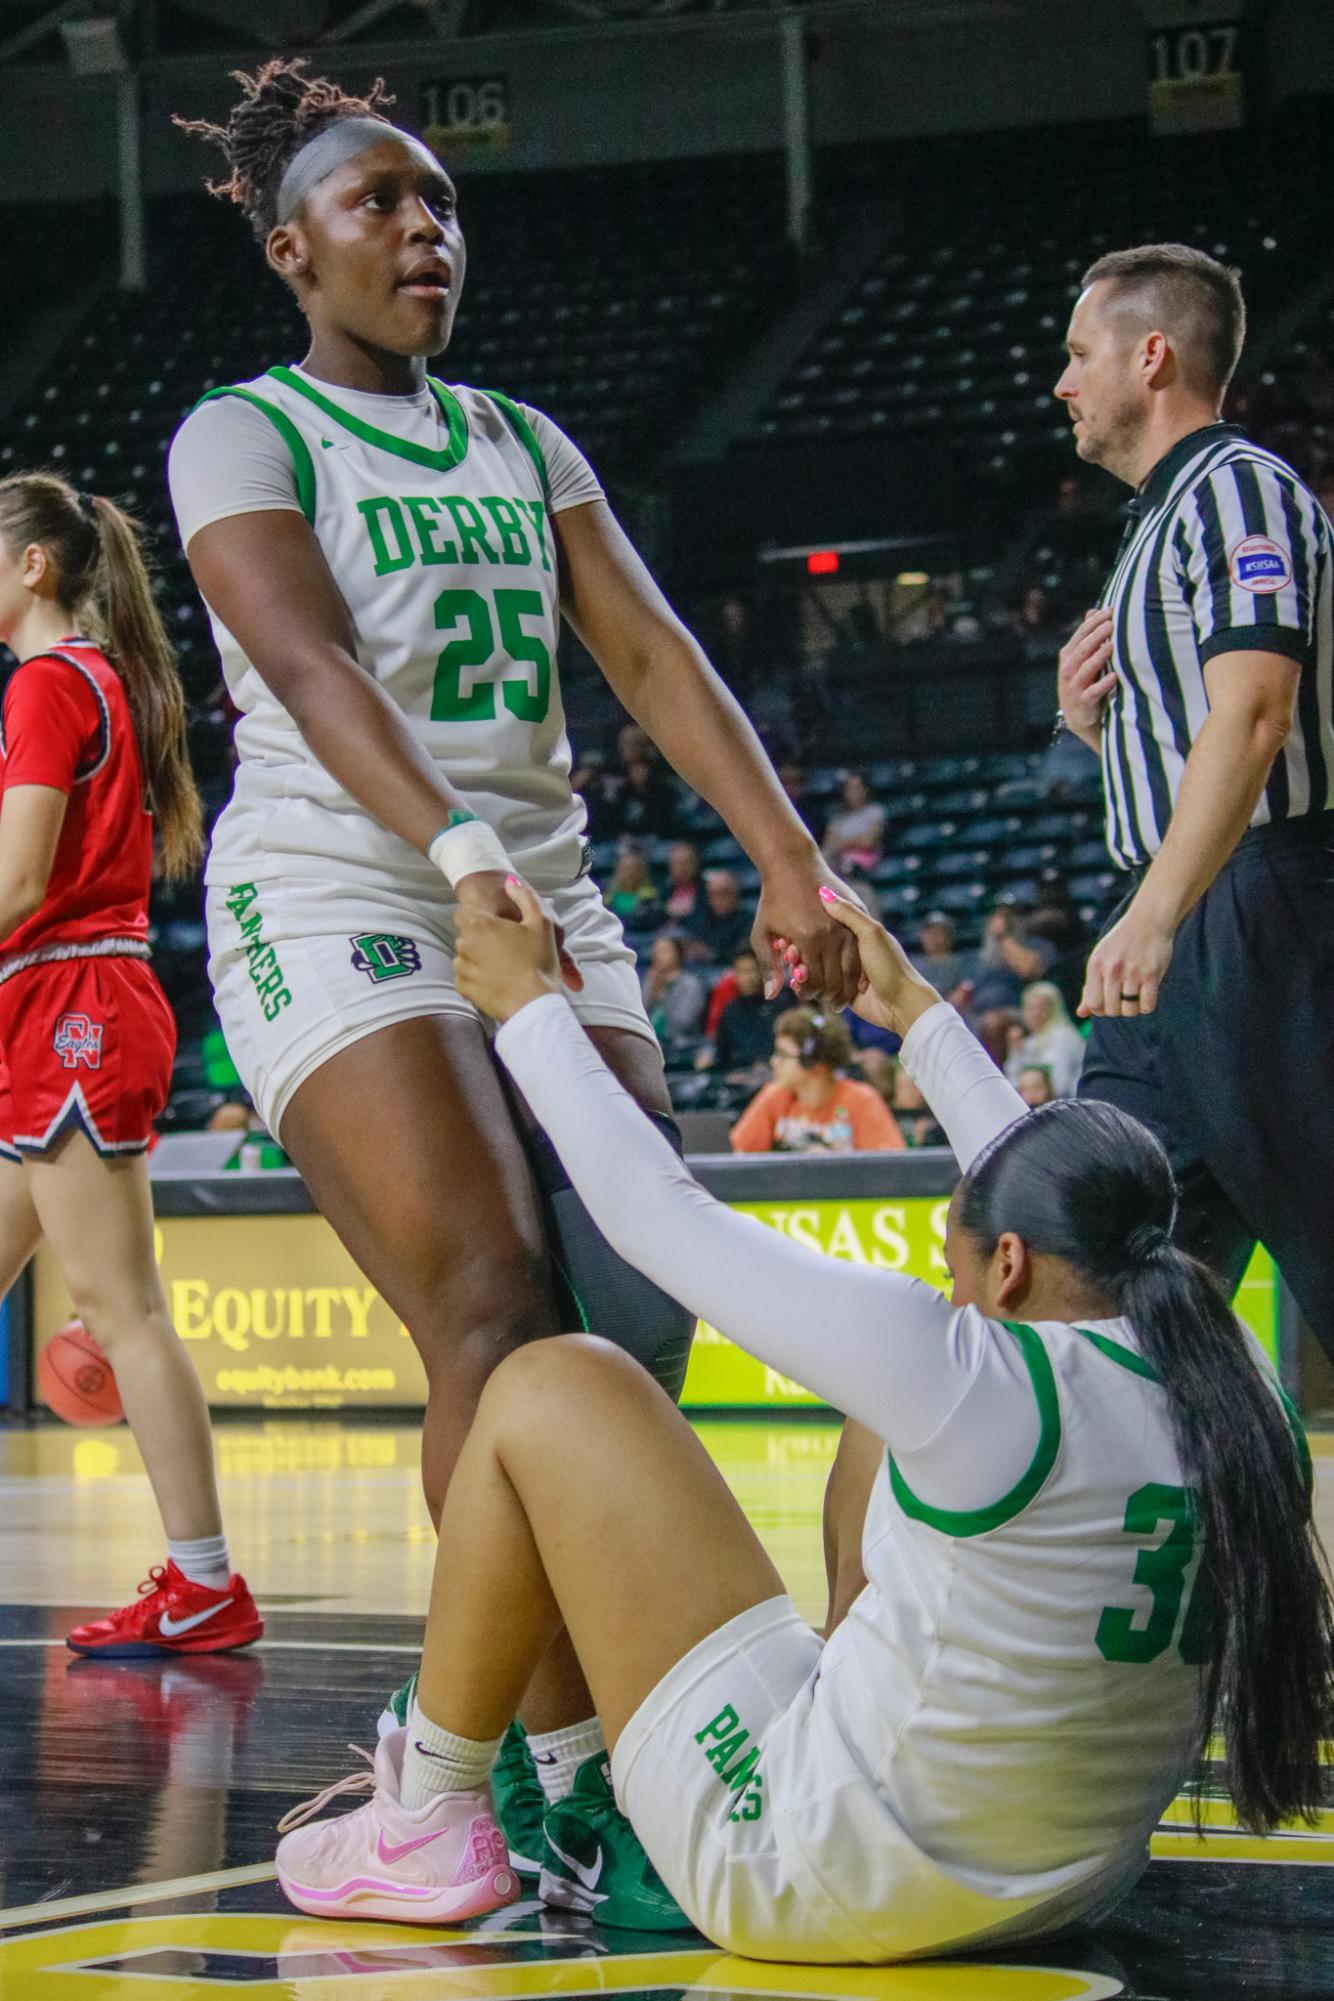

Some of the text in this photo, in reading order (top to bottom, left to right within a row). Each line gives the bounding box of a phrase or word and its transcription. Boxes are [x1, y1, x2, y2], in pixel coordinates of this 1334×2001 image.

[1151, 28, 1236, 81] 107
[422, 82, 505, 129] 106
[356, 495, 552, 578] DERBY
[429, 588, 550, 724] 25
[171, 1279, 379, 1351] EQUITY
[1094, 1481, 1210, 1664] 3
